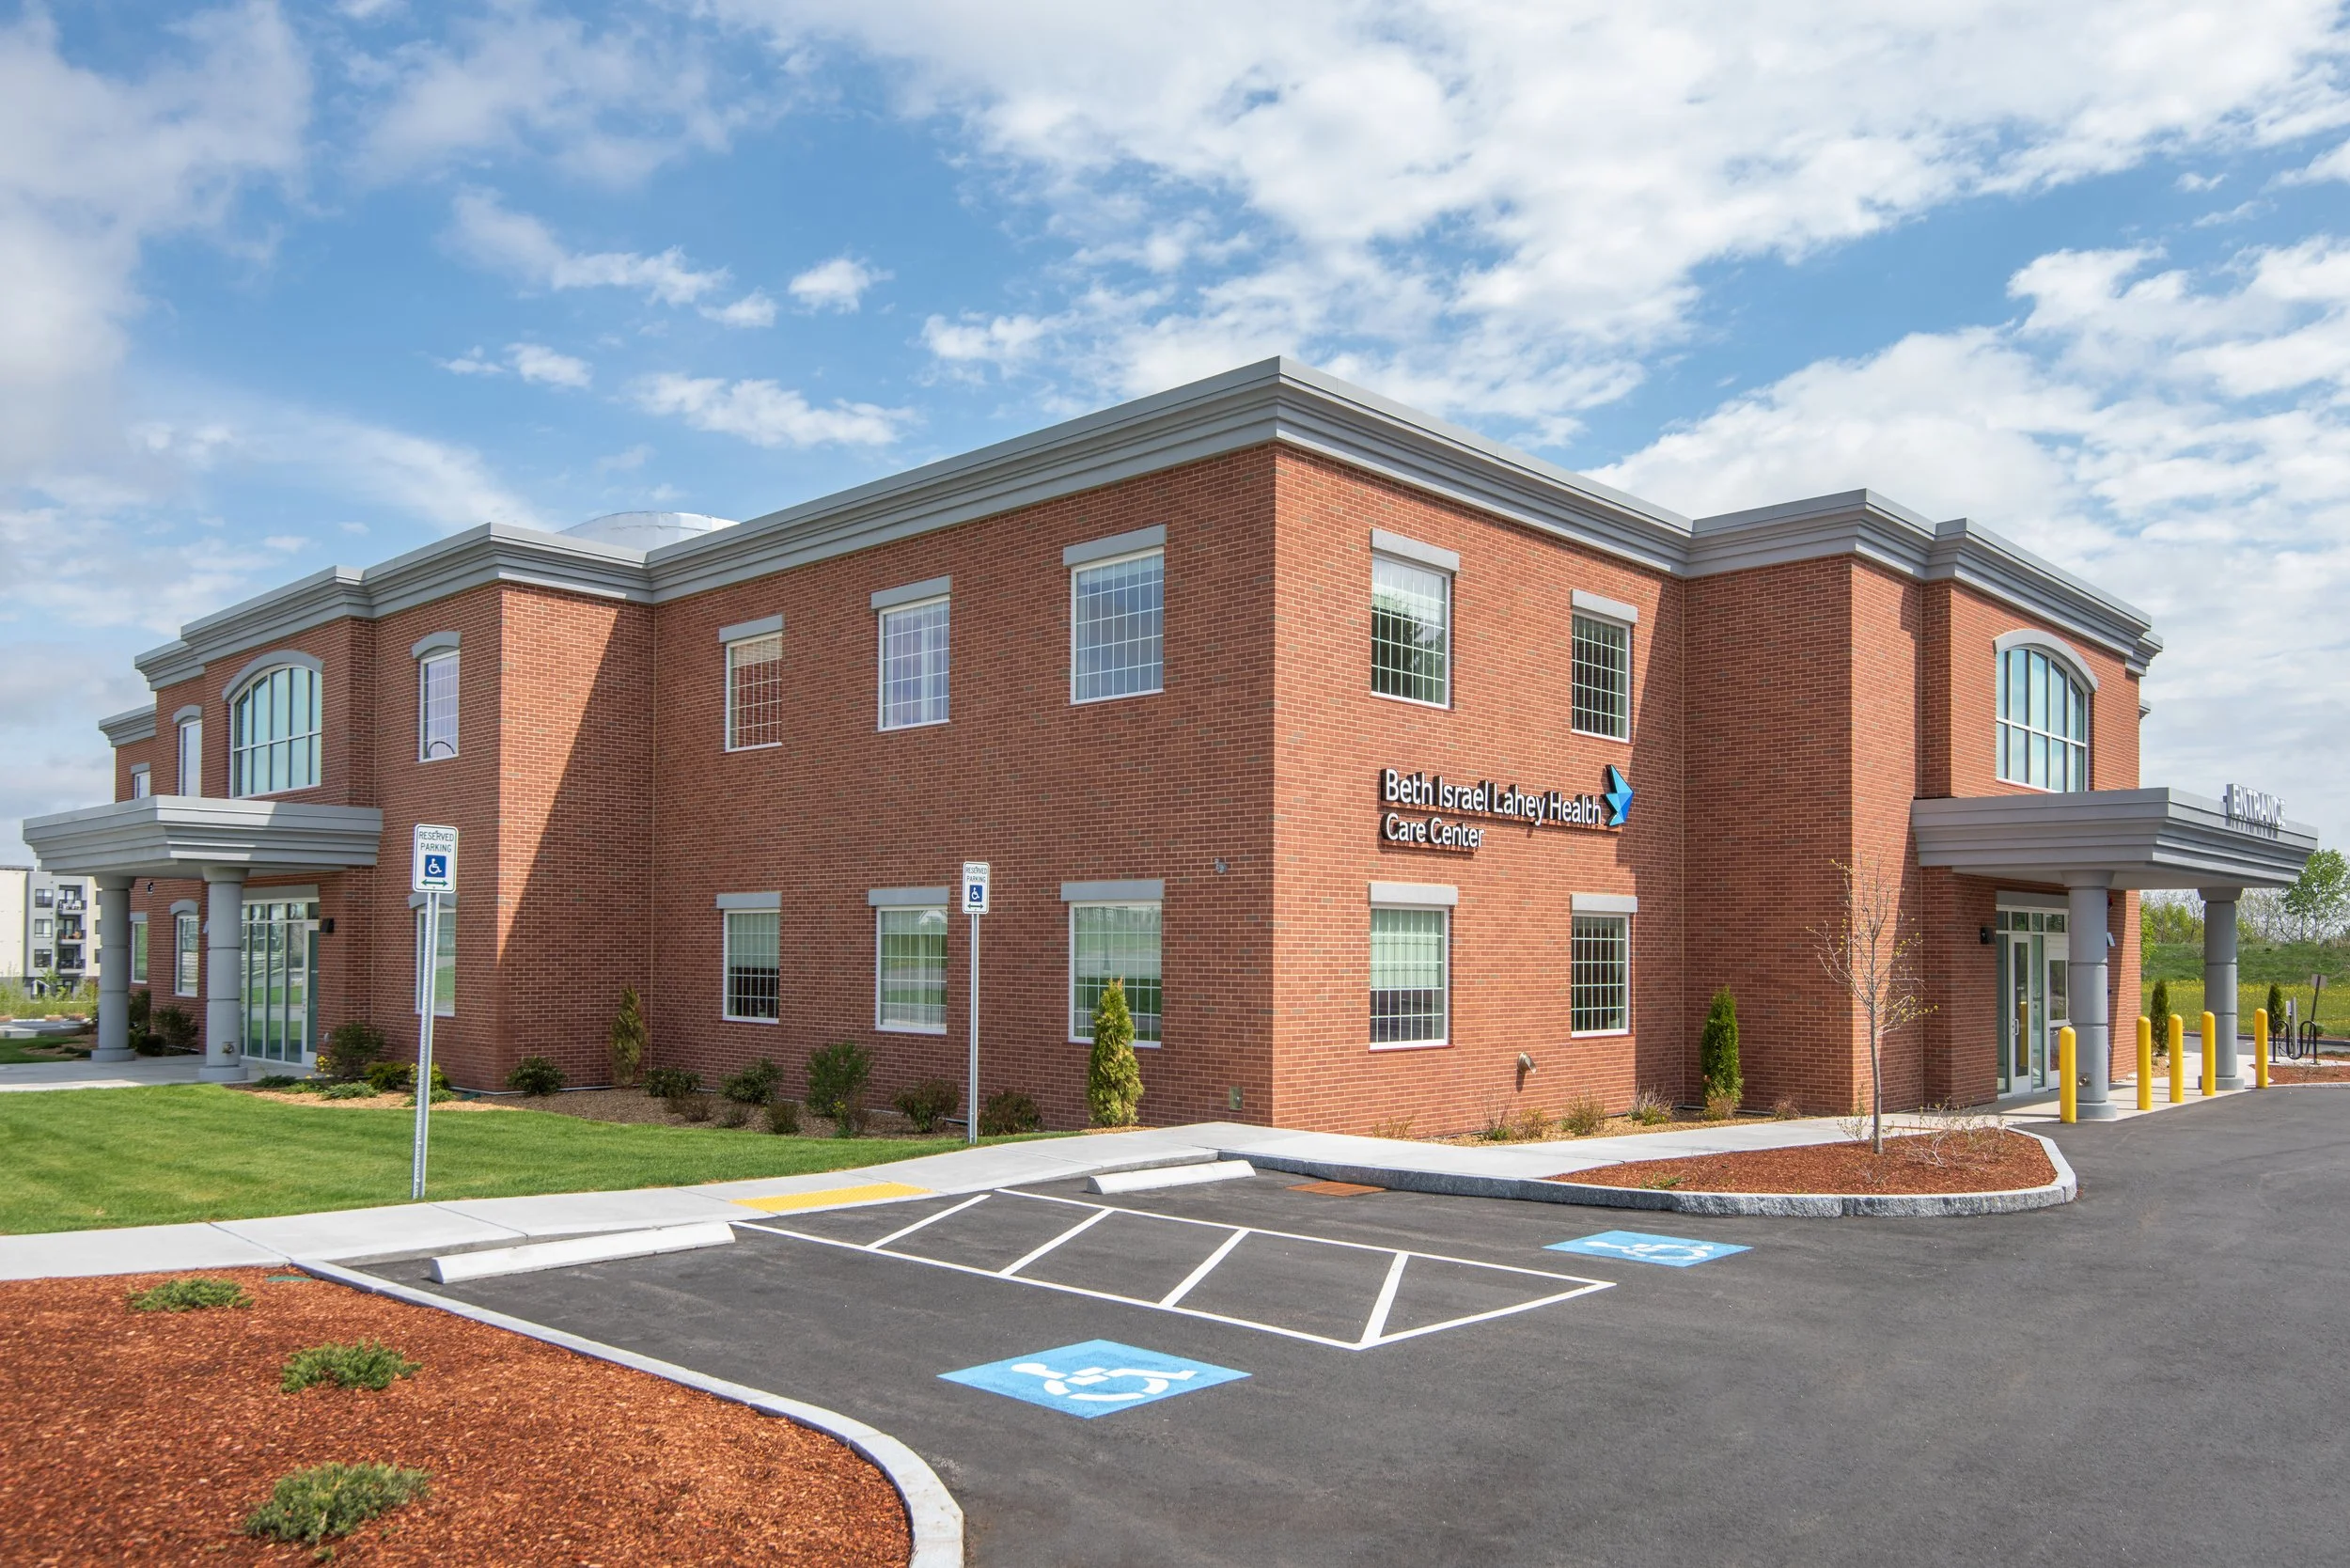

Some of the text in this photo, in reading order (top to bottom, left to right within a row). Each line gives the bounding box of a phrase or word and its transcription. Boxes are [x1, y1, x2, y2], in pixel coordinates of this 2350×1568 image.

[1383, 768, 1602, 826] Beth Israel Lahey Health
[2231, 784, 2286, 827] ENTRANCE
[1385, 812, 1485, 848] Care Center
[418, 831, 455, 842] RESERVED
[420, 842, 452, 854] PARKING
[965, 867, 987, 875] RESERVED
[966, 875, 986, 884] PARKING
